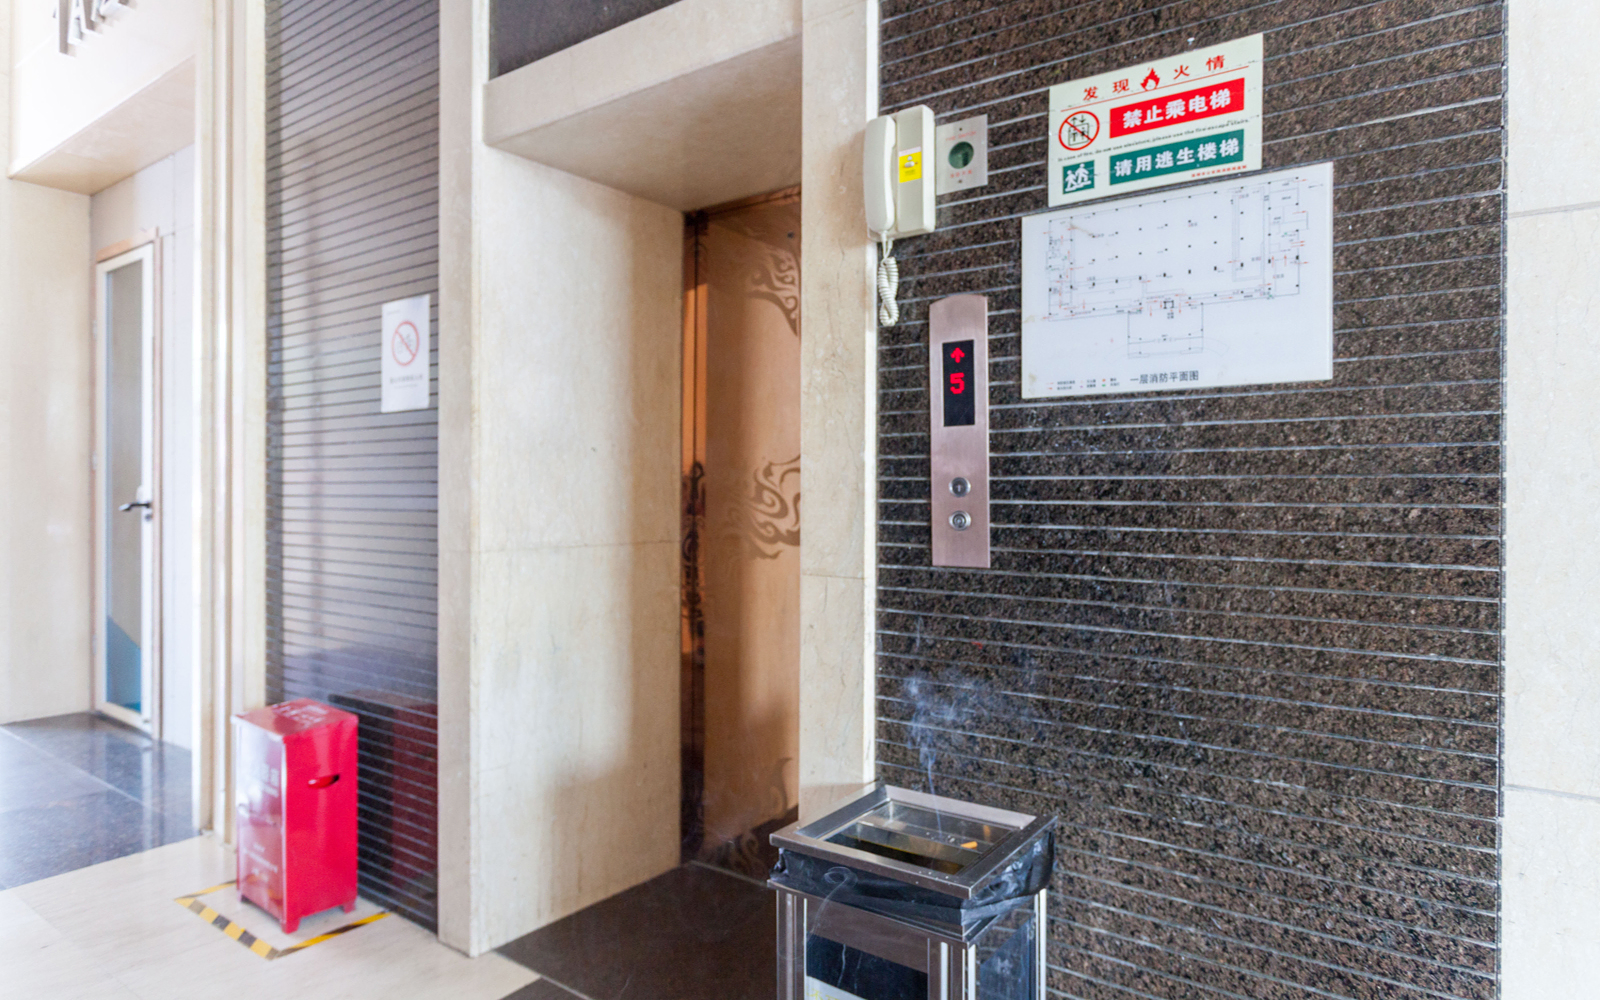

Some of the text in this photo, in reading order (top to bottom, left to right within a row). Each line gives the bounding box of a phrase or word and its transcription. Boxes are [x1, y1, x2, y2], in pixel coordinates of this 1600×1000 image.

[1083, 54, 1226, 101] 发现 火情
[1122, 88, 1232, 129] 禁止乘电梯
[1114, 138, 1240, 177] 请用逃生楼梯
[950, 372, 965, 395] 5
[1129, 369, 1200, 385] 一层消防平面图
